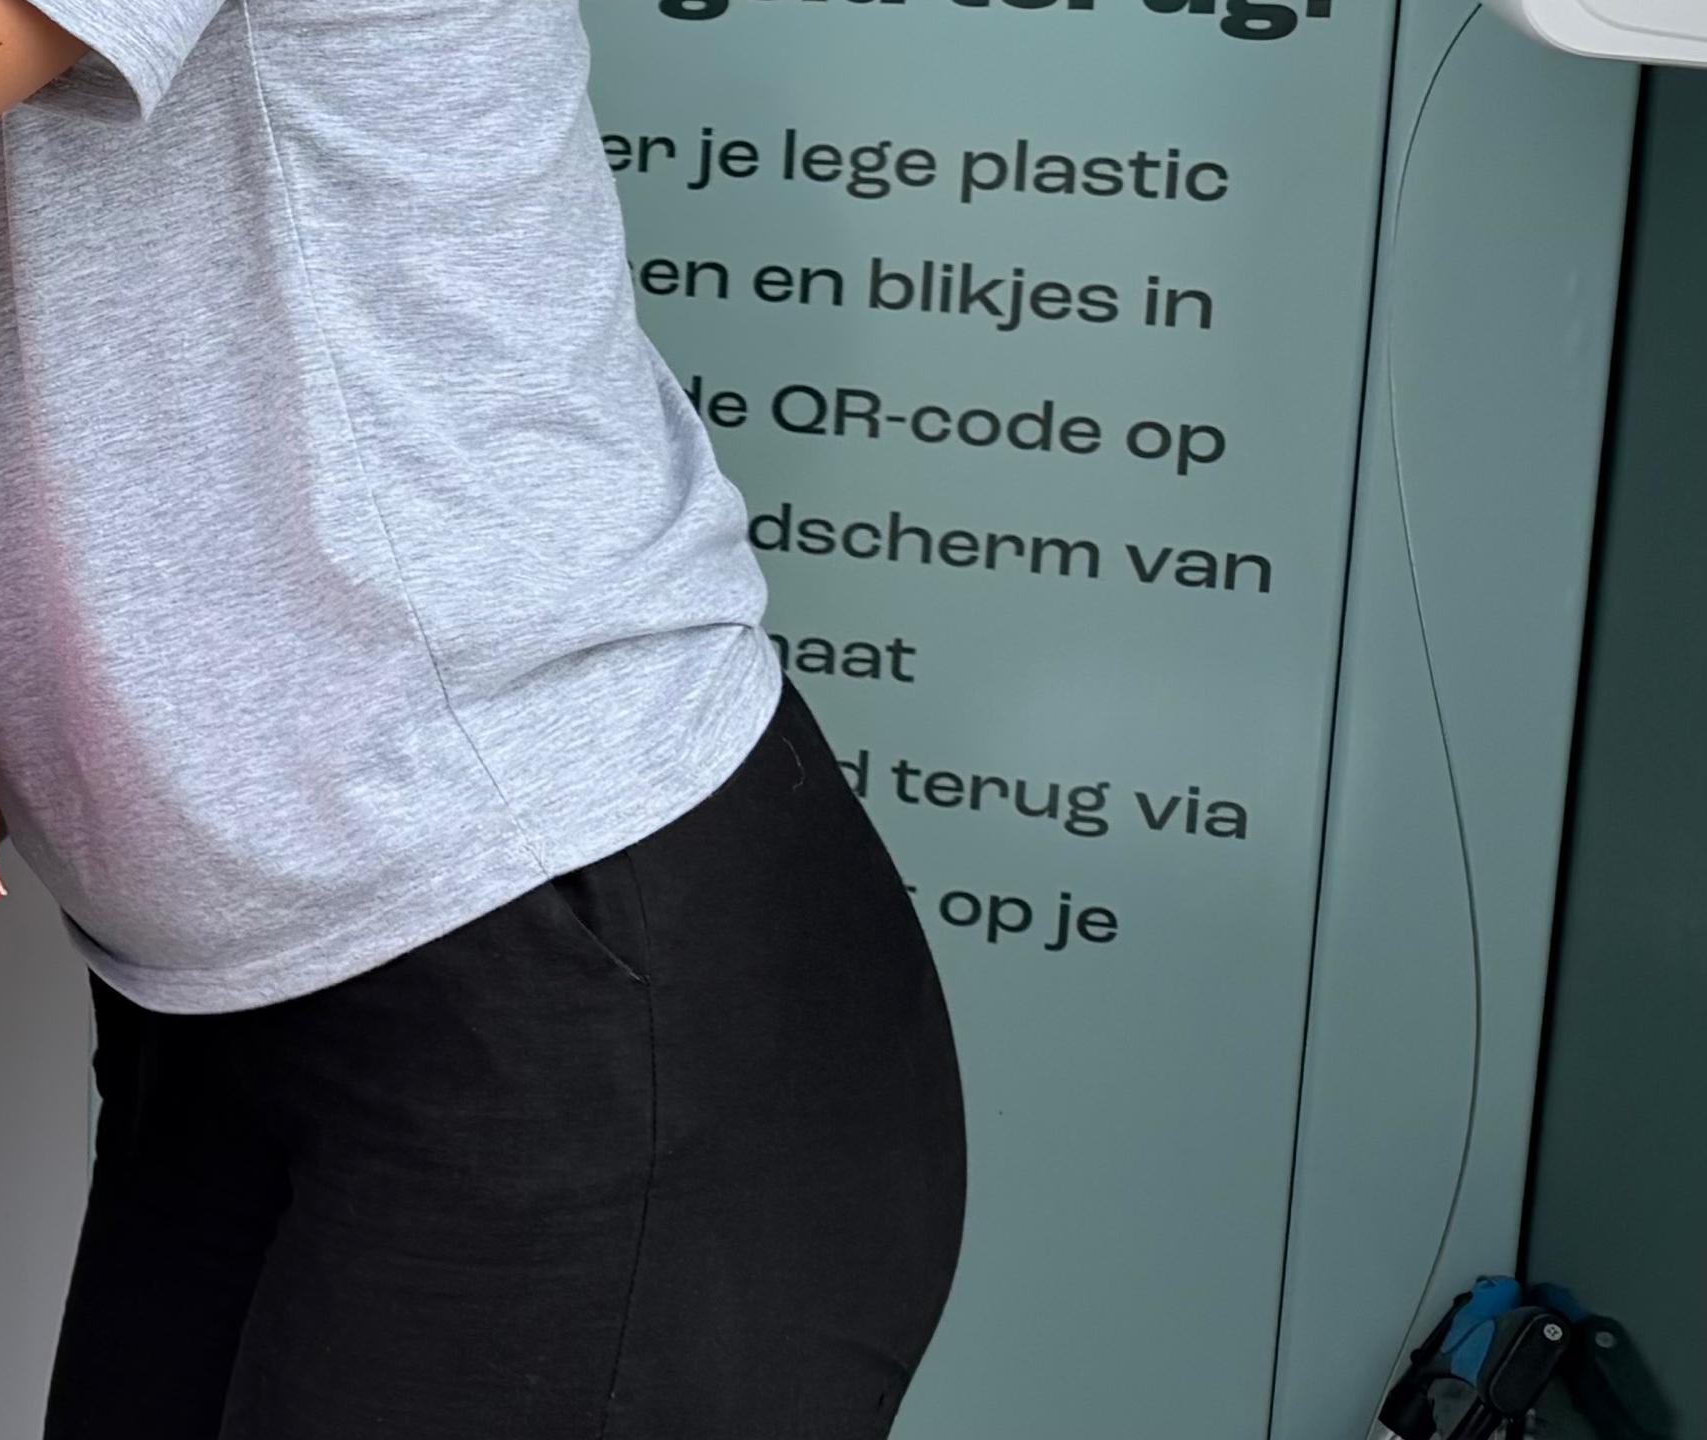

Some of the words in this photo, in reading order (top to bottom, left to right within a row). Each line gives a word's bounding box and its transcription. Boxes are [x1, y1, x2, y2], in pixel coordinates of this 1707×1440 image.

[689, 126, 760, 191] je
[782, 129, 937, 200] lege
[960, 138, 1230, 205] plastic
[628, 258, 729, 299] en
[753, 263, 844, 306] en
[869, 257, 1119, 332] blikjes
[1144, 275, 1214, 331] in
[771, 383, 1102, 454] QR-code
[1125, 418, 1227, 476] op
[1125, 543, 1273, 593] van
[891, 759, 1111, 838] terug
[1135, 786, 1249, 840] via
[938, 888, 1034, 945] op
[1044, 892, 1119, 951] je
